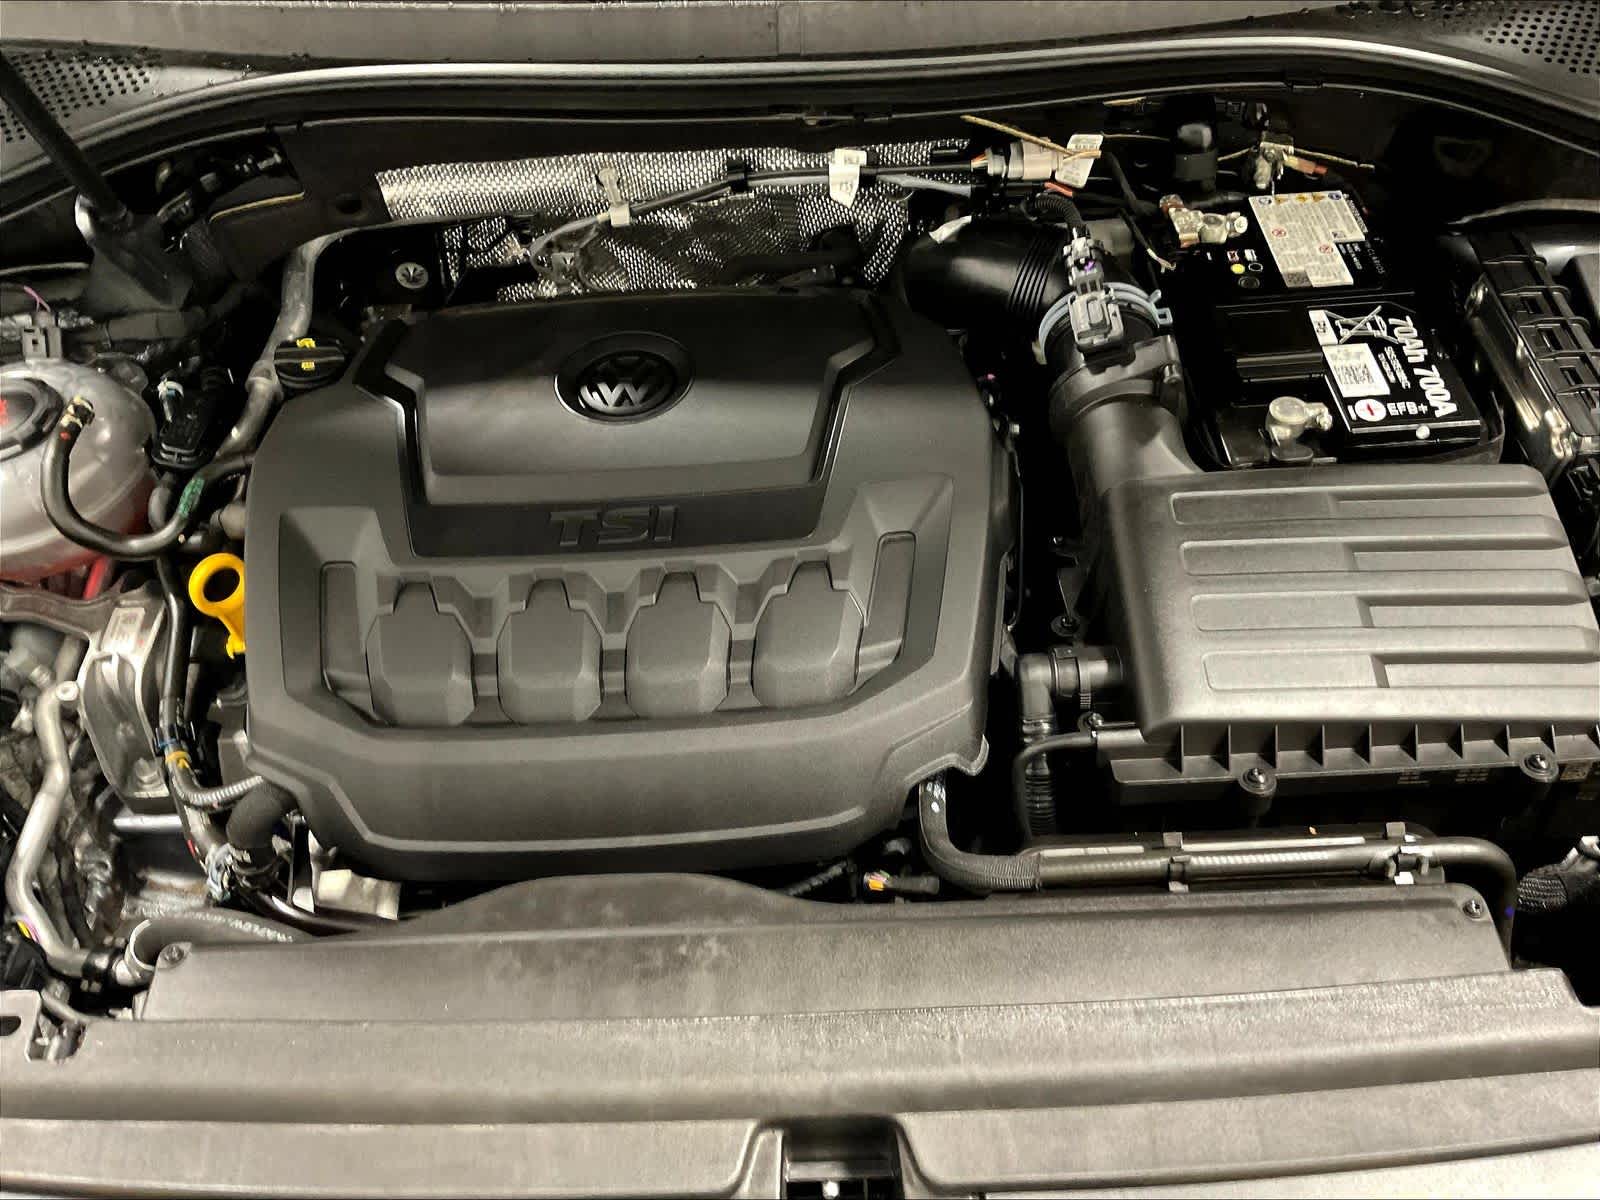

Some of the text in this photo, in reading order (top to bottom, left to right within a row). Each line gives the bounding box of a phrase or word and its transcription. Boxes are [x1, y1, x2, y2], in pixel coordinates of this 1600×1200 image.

[1388, 315, 1428, 363] 70Ah
[1413, 364, 1457, 418] 700A
[1386, 401, 1428, 416] EFB+
[550, 504, 677, 545] TSI
